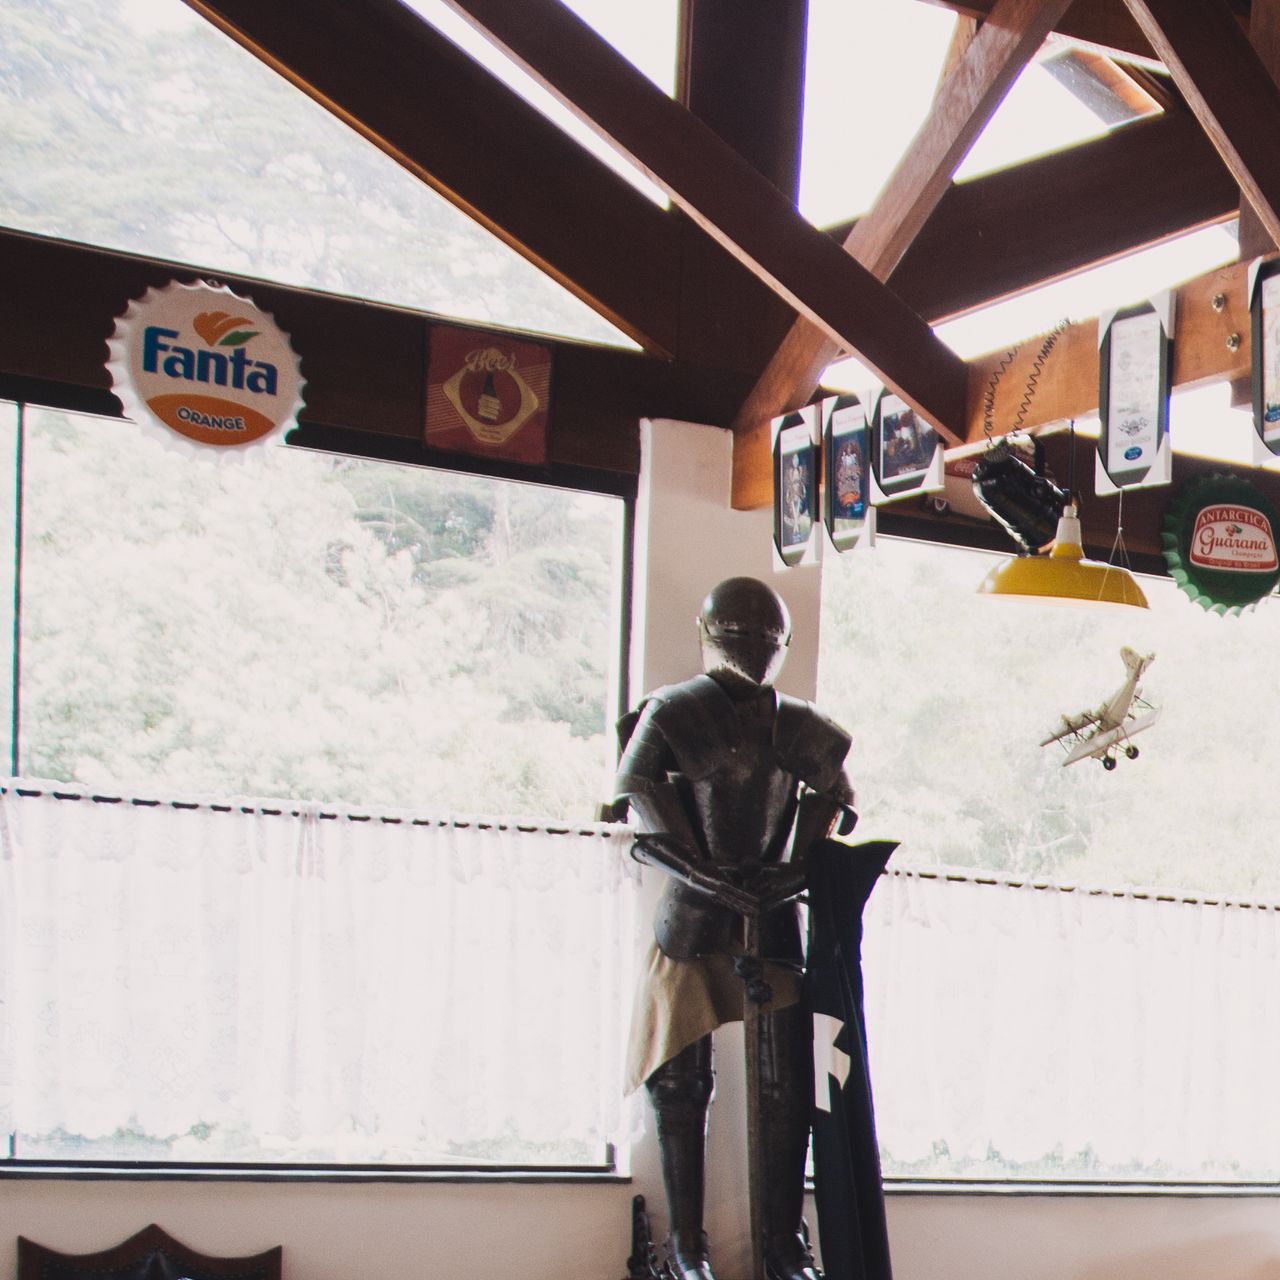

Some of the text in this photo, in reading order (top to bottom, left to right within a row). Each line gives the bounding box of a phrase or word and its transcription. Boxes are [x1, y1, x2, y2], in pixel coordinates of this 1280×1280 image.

[143, 325, 279, 396] Fanta
[176, 406, 246, 431] ORANGE
[1200, 510, 1269, 533] ANTARCTICA
